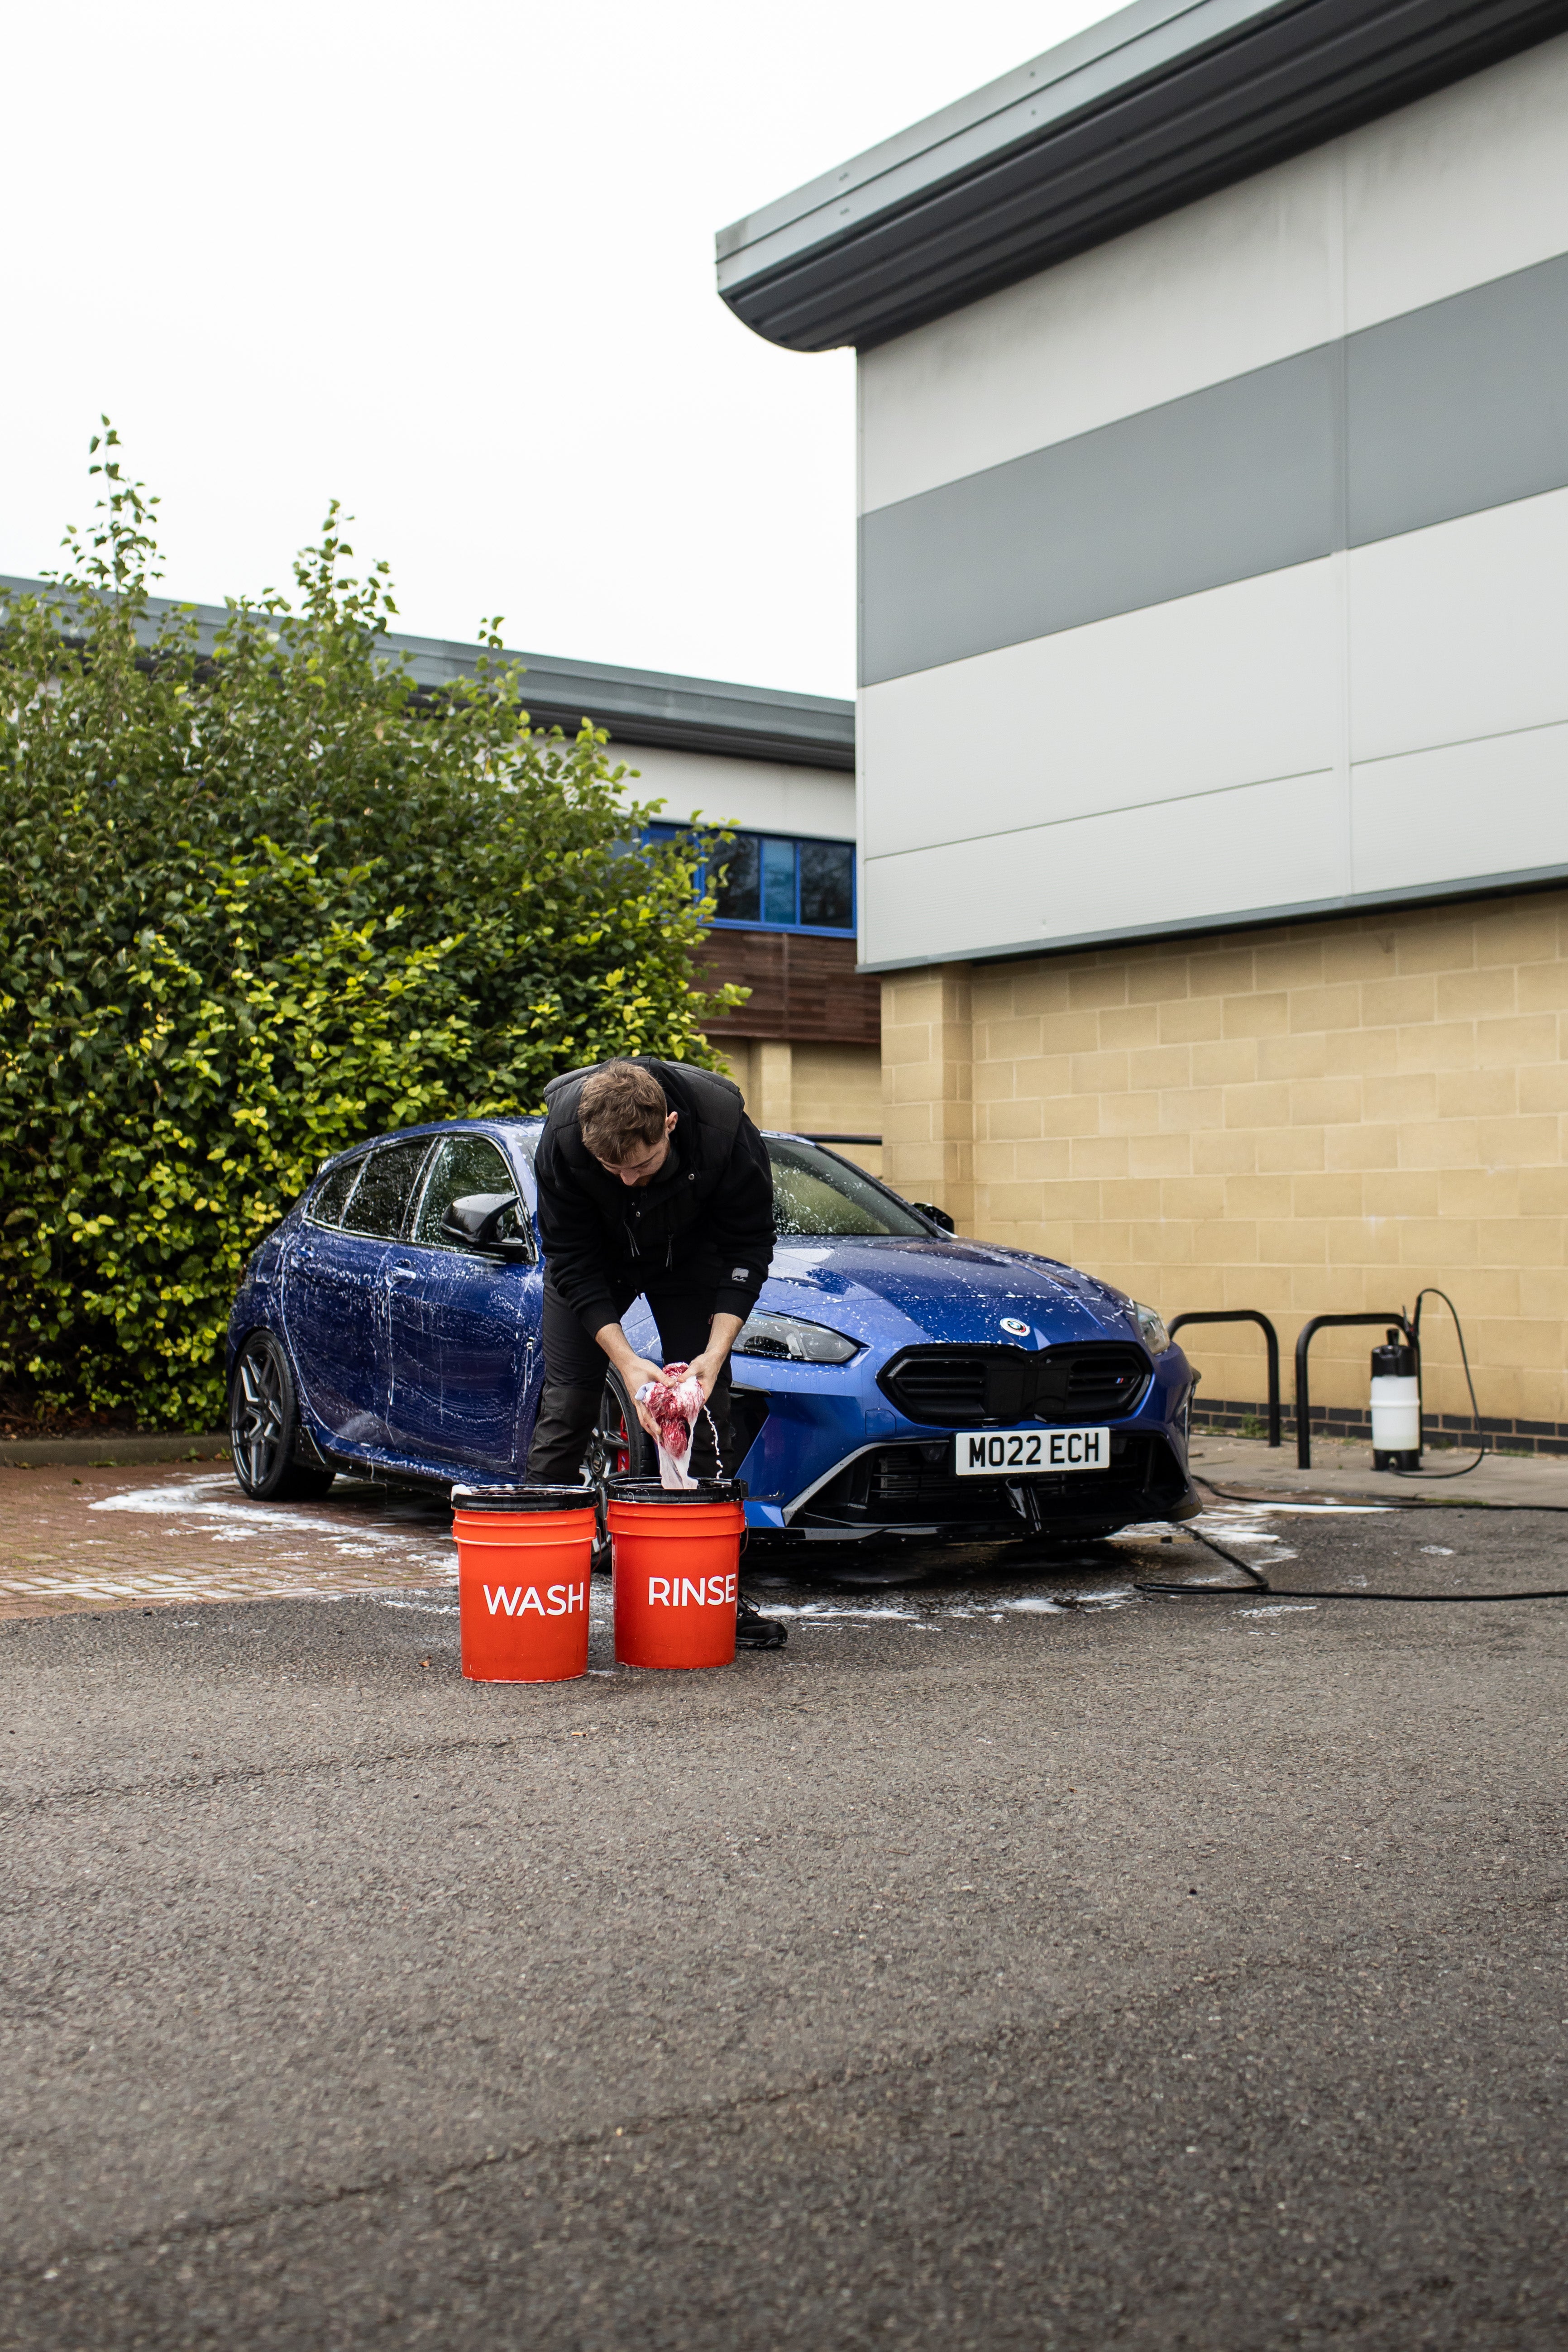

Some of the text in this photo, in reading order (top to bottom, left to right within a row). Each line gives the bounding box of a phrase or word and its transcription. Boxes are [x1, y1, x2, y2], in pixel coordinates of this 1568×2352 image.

[969, 1432, 1100, 1468] MO22 ECH
[483, 1582, 584, 1616] WASH
[648, 1573, 736, 1607] RINSE
